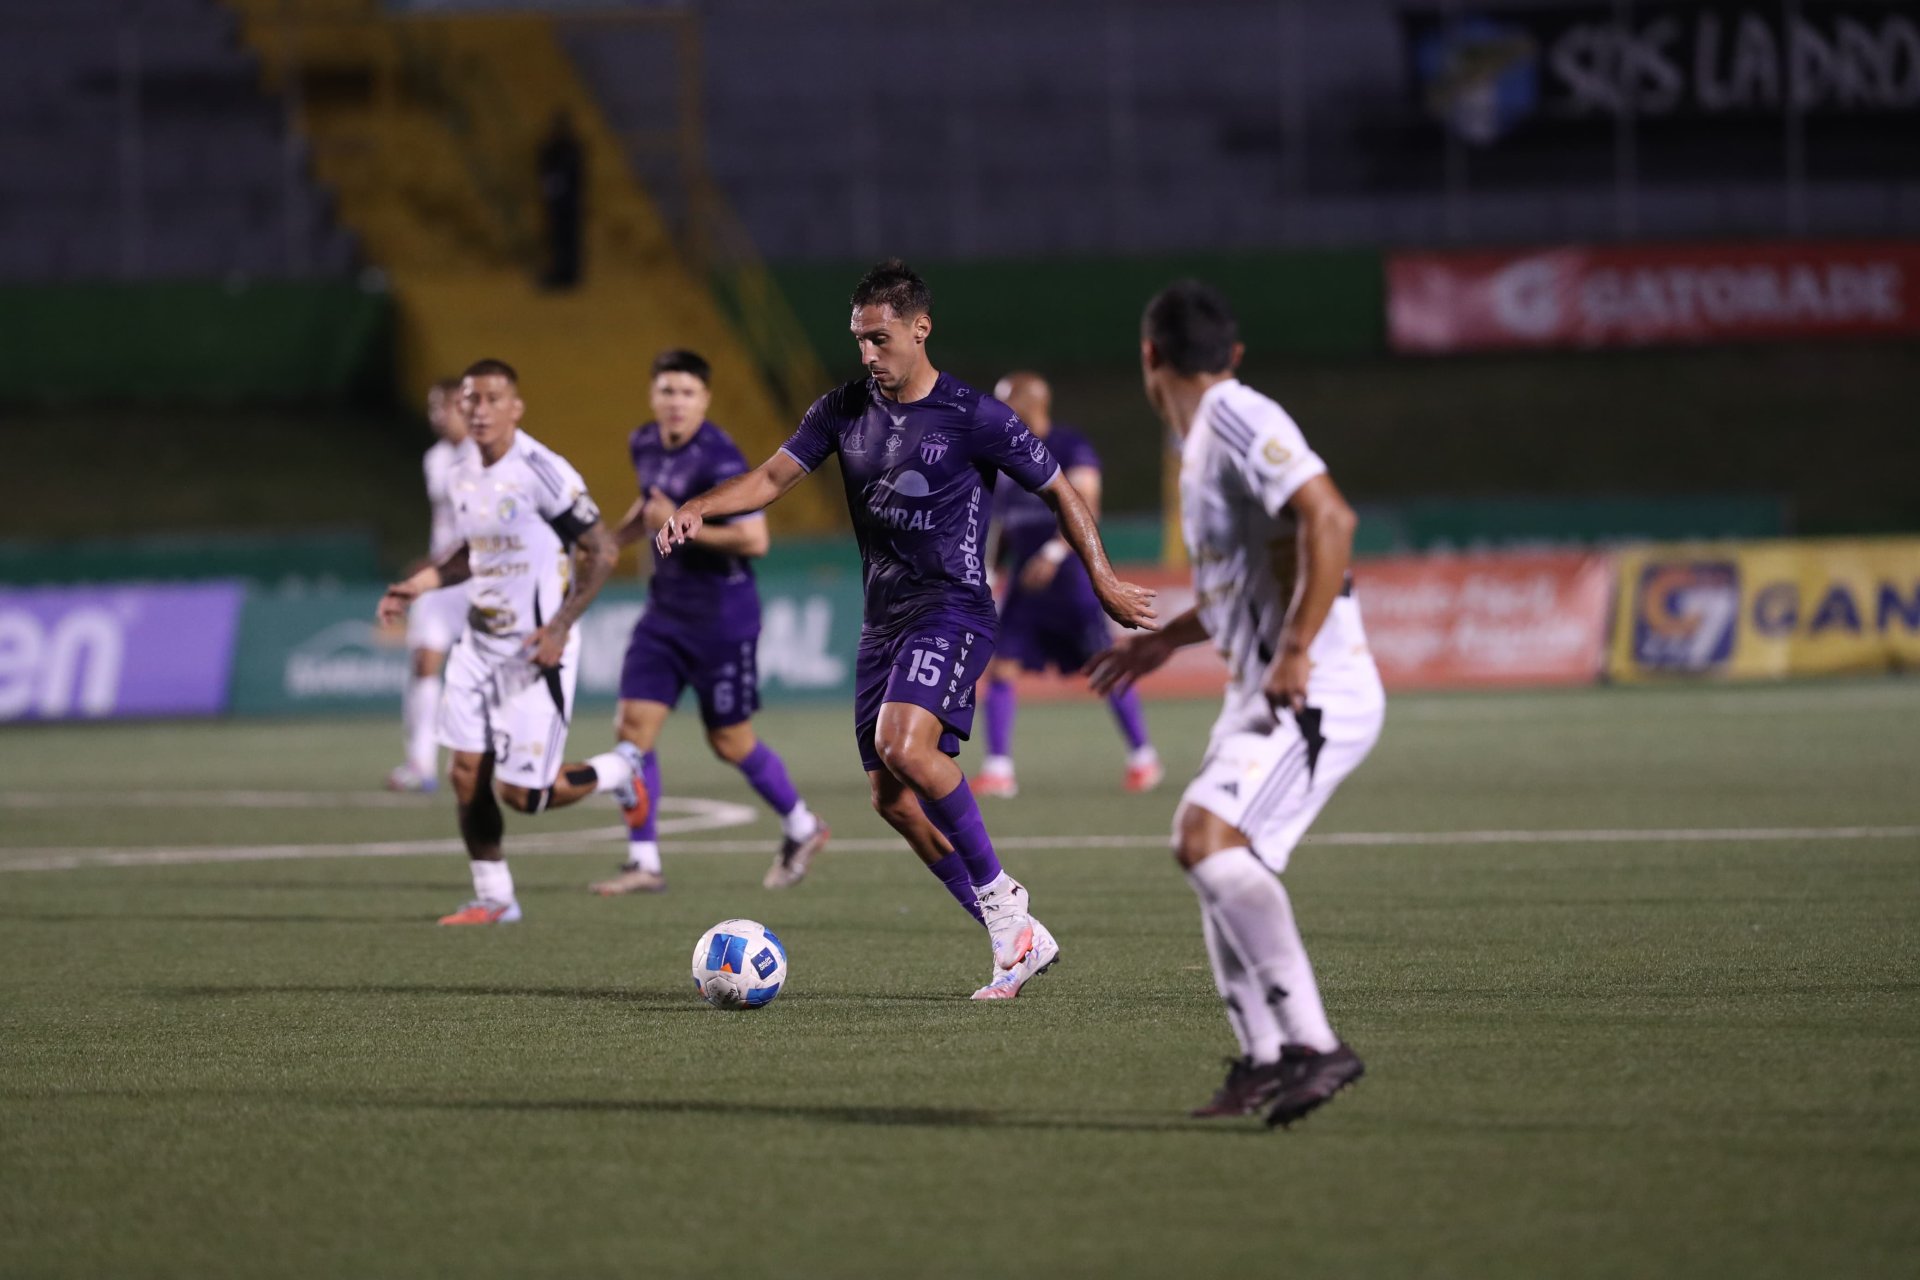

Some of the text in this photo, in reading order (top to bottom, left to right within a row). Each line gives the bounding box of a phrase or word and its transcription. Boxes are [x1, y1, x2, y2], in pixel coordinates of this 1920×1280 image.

[1582, 262, 1902, 328] GATORADE
[959, 485, 982, 587] betcris
[1752, 578, 1920, 638] GAN
[906, 648, 946, 687] 15
